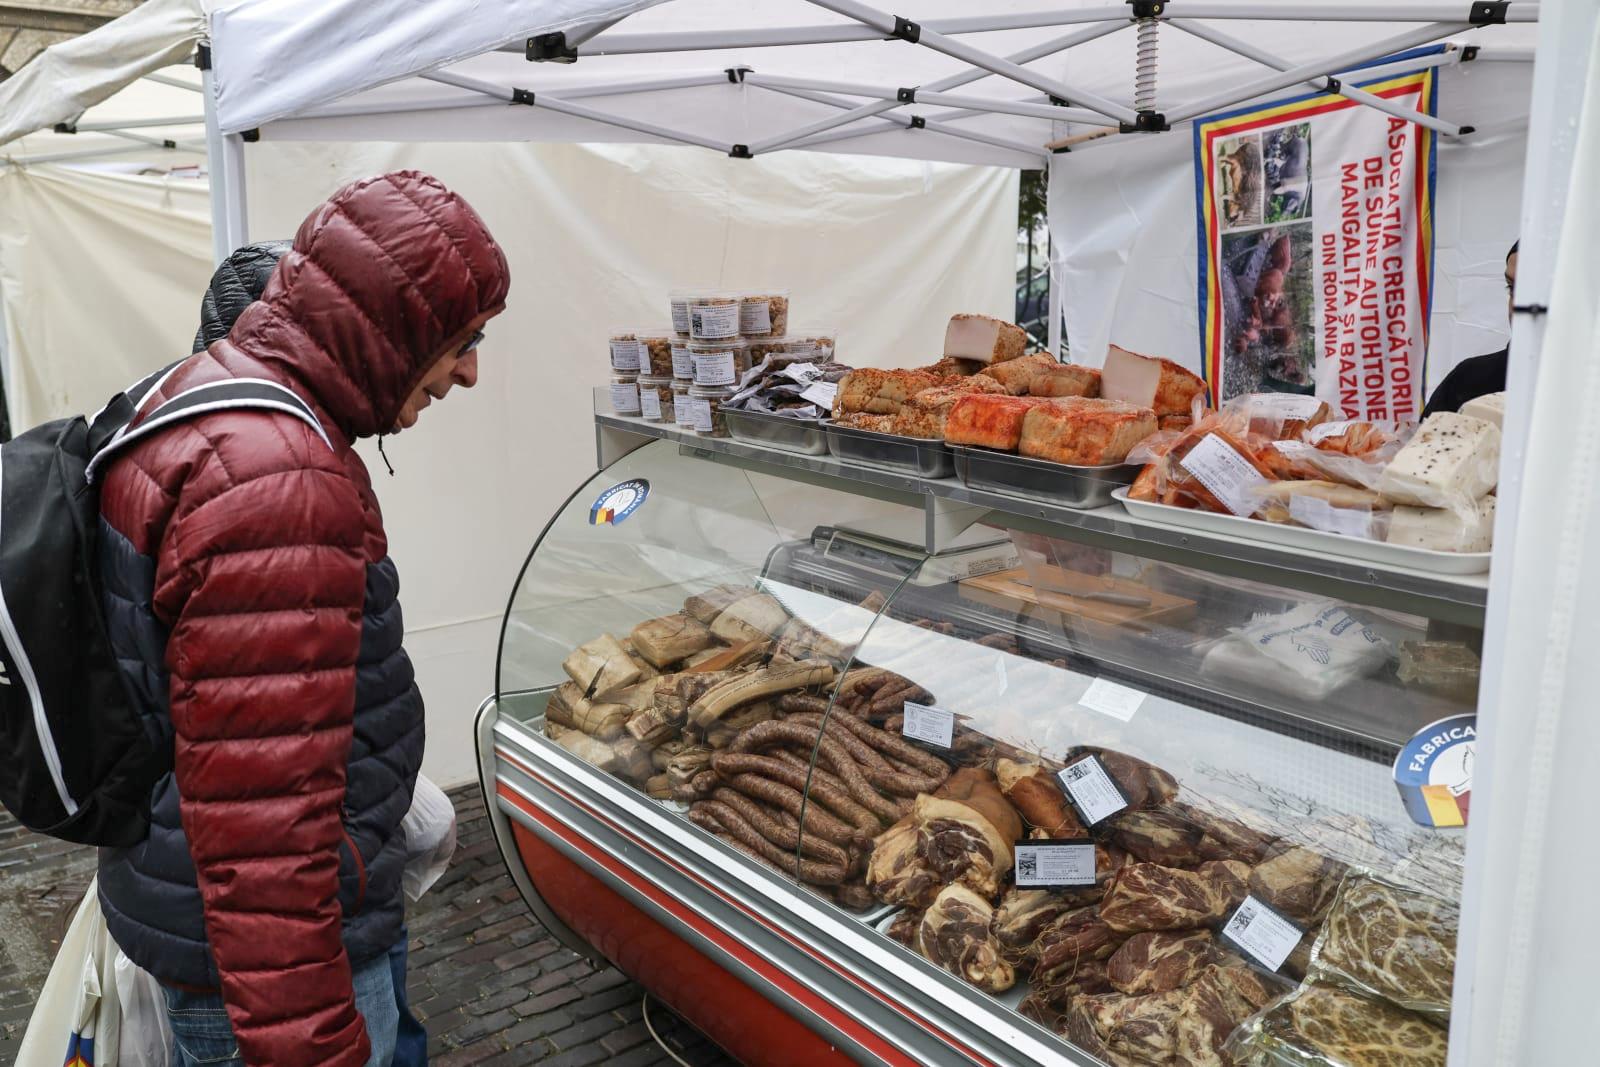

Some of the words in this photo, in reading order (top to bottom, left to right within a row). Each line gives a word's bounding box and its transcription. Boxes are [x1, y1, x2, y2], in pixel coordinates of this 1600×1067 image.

[1363, 156, 1384, 190] DE
[1321, 233, 1337, 266] DIN
[1365, 196, 1383, 271] SUINE
[1338, 342, 1360, 421] BAZNA
[1360, 279, 1387, 421] AUTOHTONE
[1382, 256, 1413, 432] CRESCĂTORIL
[1408, 726, 1476, 772] FABRICA
